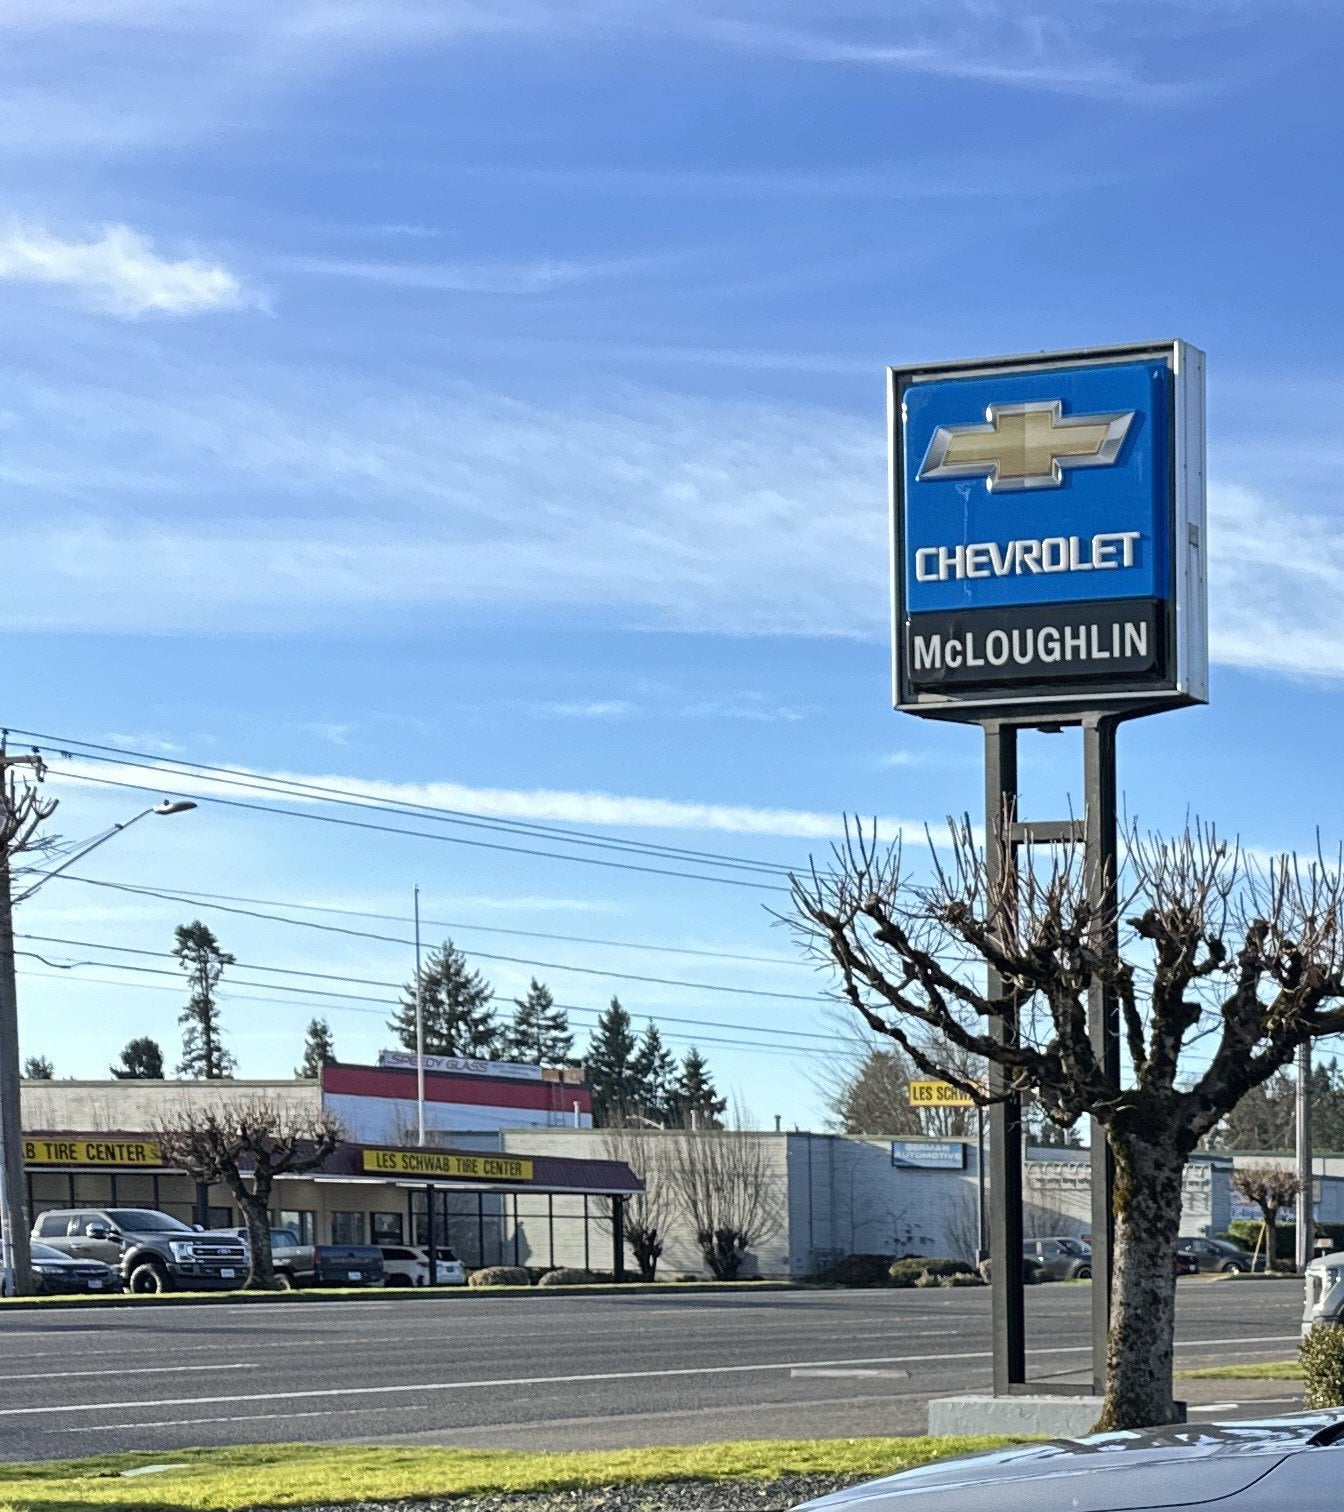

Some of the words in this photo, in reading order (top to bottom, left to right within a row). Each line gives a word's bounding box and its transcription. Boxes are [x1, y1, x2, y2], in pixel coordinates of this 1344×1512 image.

[916, 531, 1141, 582] CHEVROLET
[914, 621, 1148, 669] McLOUGHLIN
[388, 1054, 443, 1068] SPEDY
[446, 1059, 488, 1073] GLASS
[912, 1086, 933, 1101] LES
[44, 1142, 78, 1160] TIRE
[85, 1143, 145, 1162] CENTER
[376, 1152, 396, 1169] LES
[401, 1153, 450, 1172] SCHWAB
[455, 1158, 478, 1174] TIRE
[483, 1160, 522, 1176] CENTER
